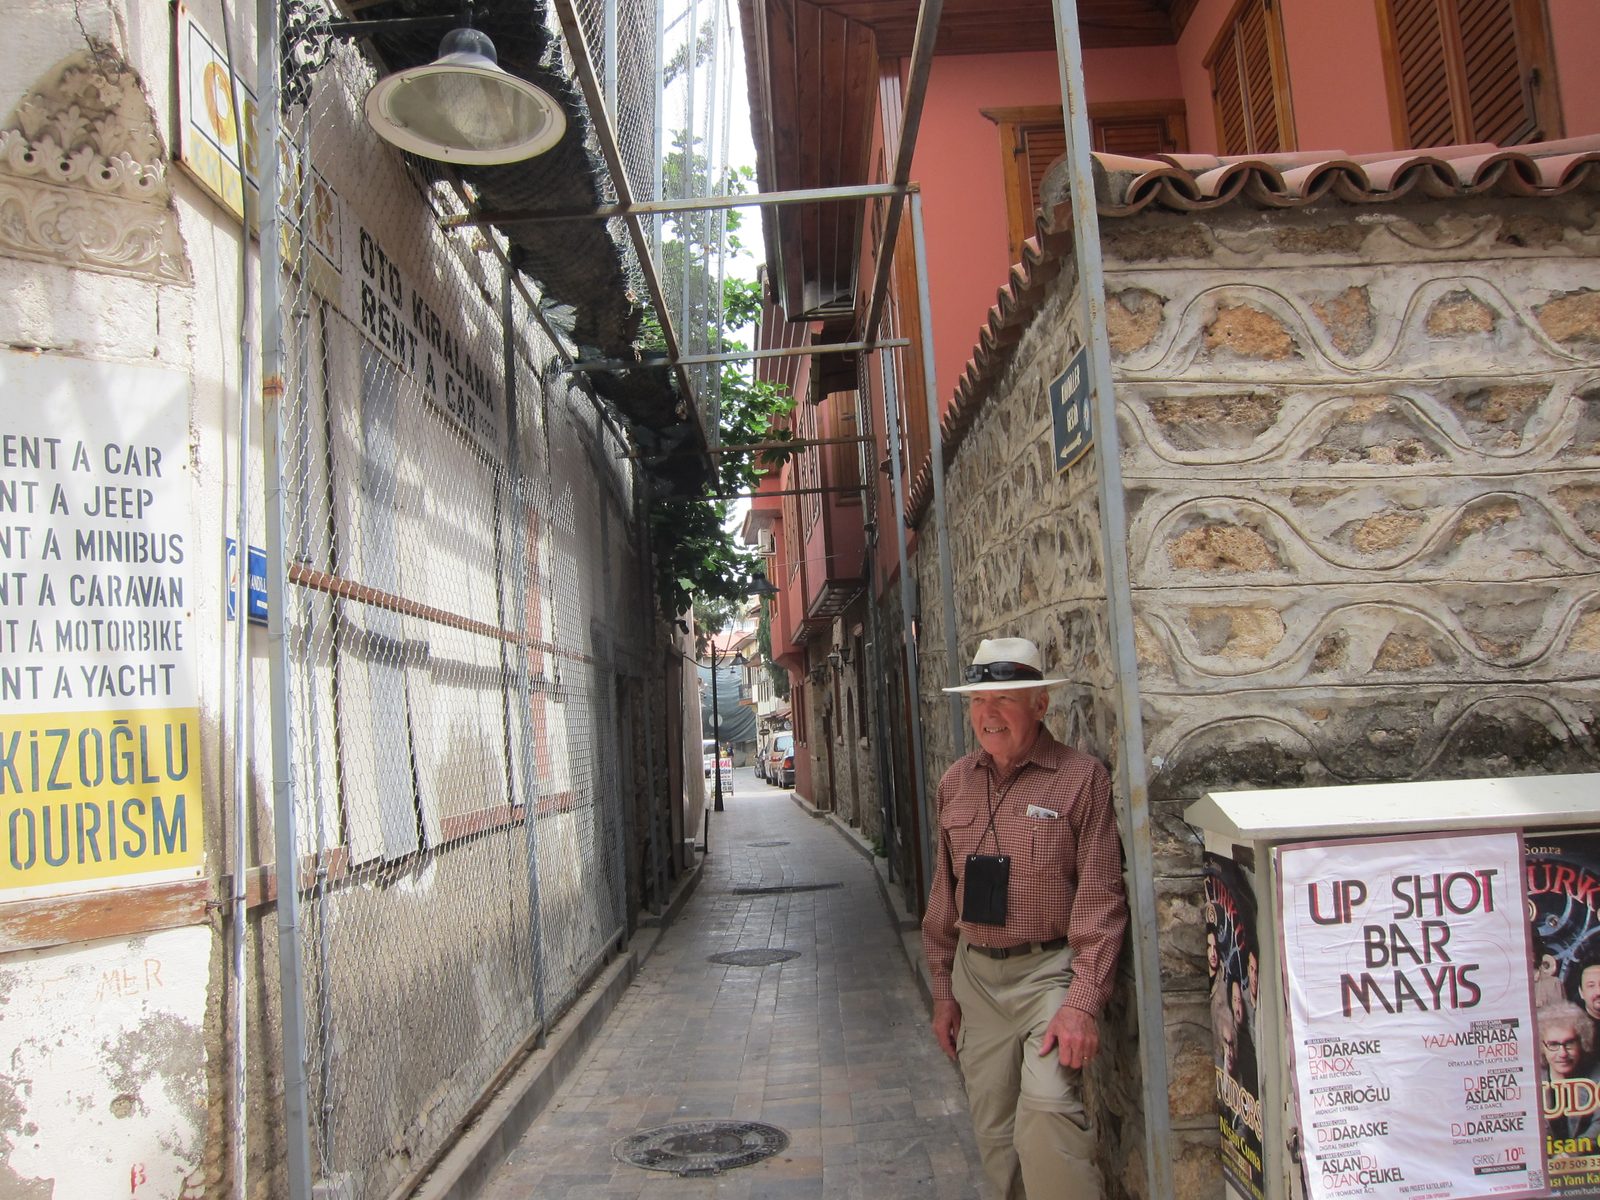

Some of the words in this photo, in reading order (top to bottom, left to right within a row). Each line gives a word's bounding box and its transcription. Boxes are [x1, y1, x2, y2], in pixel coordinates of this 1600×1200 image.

[360, 226, 402, 311] OTO
[361, 279, 418, 372] RENT
[426, 352, 436, 395] A
[445, 373, 476, 434] CAR
[72, 440, 91, 473] A
[103, 441, 162, 478] CAR
[50, 483, 70, 516] A
[84, 485, 153, 520] JEEP
[41, 528, 62, 561] A
[75, 529, 184, 565] MINIBUS
[38, 573, 56, 606] A
[69, 573, 184, 608] CARAVAN
[28, 619, 44, 653] A
[56, 619, 184, 653] MOTORBIKE
[53, 666, 73, 699] A
[81, 663, 176, 697] YACHT
[8, 794, 188, 872] OURISM
[1525, 844, 1561, 856] Sonra
[1308, 879, 1368, 926] UP
[1391, 868, 1498, 920] SHOT
[1363, 920, 1452, 969] BAR
[1340, 963, 1481, 1018] MAYIS
[1542, 1078, 1600, 1119] UD
[1546, 1135, 1592, 1155] isan
[1548, 1161, 1566, 1171] 507
[1570, 1159, 1588, 1168] 509
